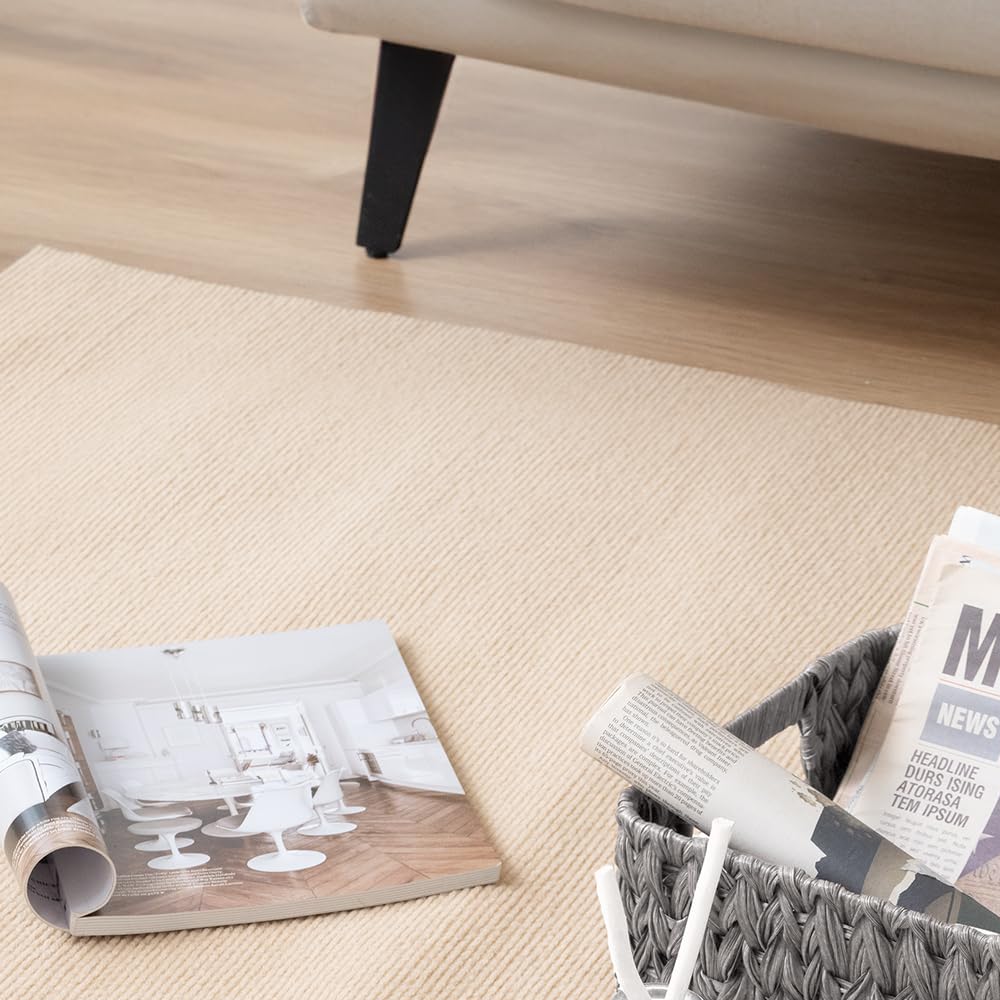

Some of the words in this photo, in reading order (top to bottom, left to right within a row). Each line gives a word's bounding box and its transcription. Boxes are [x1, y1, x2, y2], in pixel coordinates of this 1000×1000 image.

[619, 722, 645, 742] determine
[622, 715, 634, 725] One
[633, 723, 651, 737] reason
[650, 716, 658, 725] the
[936, 702, 1000, 740] NEWS
[599, 735, 626, 756] discussion
[632, 757, 653, 774] General
[603, 729, 627, 748] packages
[628, 746, 637, 755] are
[699, 794, 708, 803] the
[606, 748, 630, 766] practices
[607, 723, 619, 733] that
[649, 751, 680, 775] descriptions
[687, 777, 701, 789] their
[701, 786, 712, 797] pay
[910, 749, 980, 780] HEADLINE
[896, 780, 962, 809] ATORASA
[904, 764, 944, 787] DURS
[946, 777, 985, 799] ISING
[891, 794, 921, 813] TEM
[922, 803, 970, 828] IPSUM
